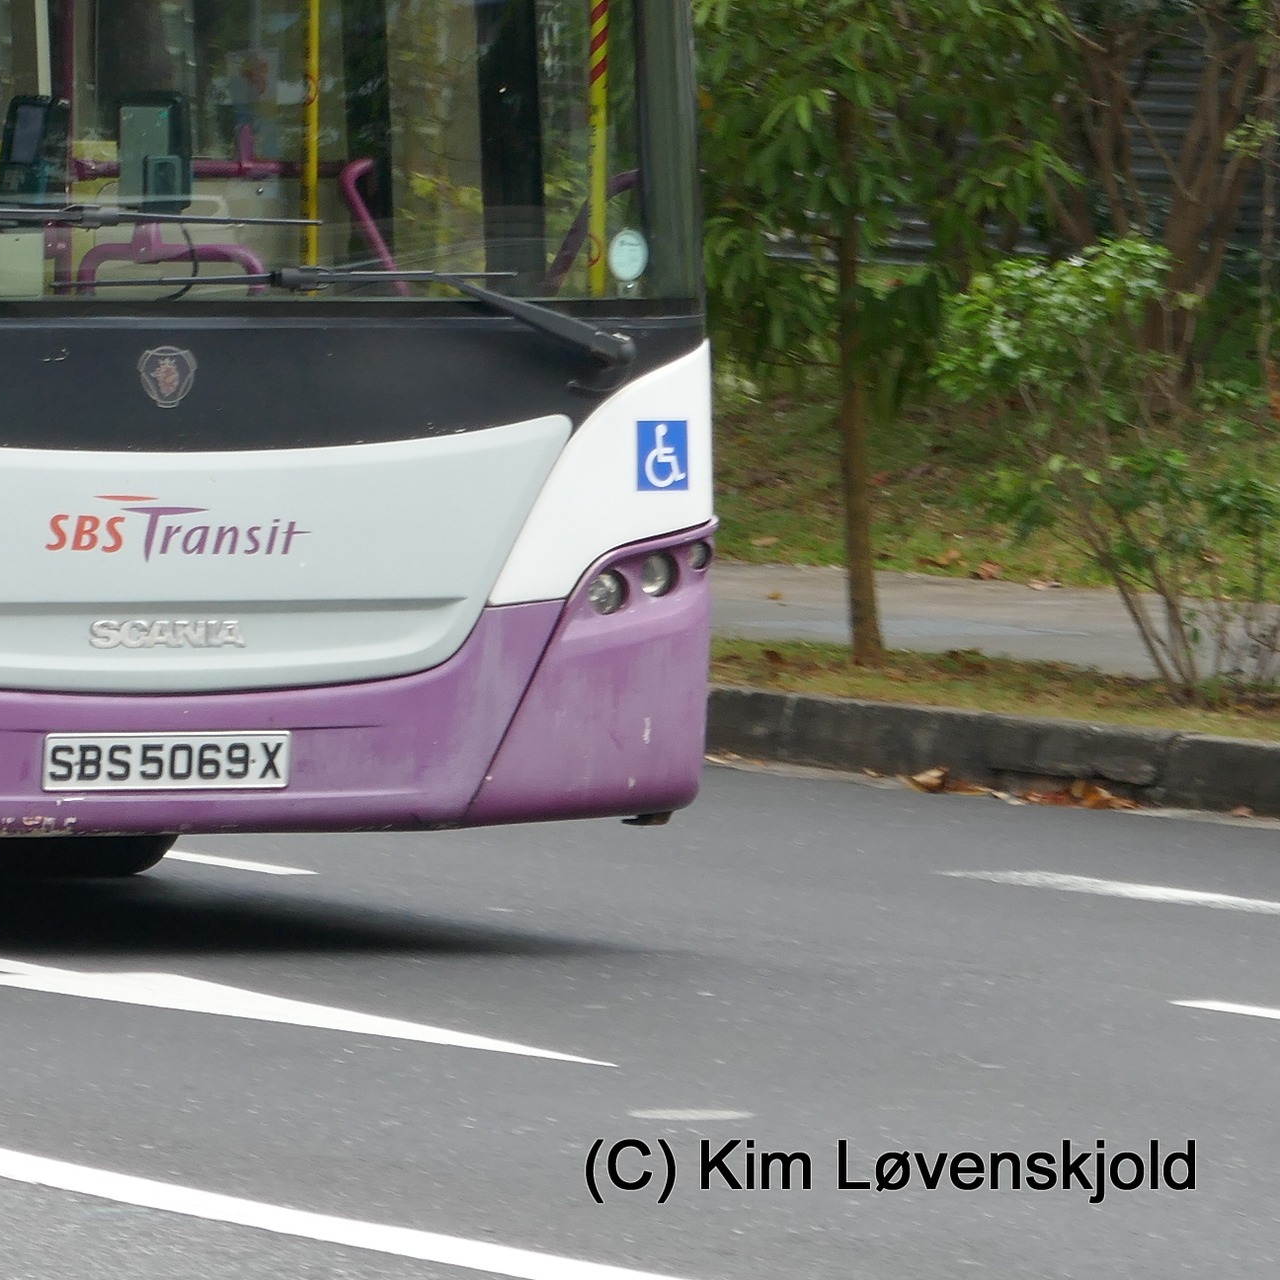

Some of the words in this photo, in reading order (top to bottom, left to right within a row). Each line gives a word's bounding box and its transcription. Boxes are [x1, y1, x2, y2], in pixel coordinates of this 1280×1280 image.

[44, 513, 125, 553] SBS
[119, 506, 312, 562] Transit
[89, 620, 246, 649] SCANIA
[49, 742, 283, 781] SBS5069X
